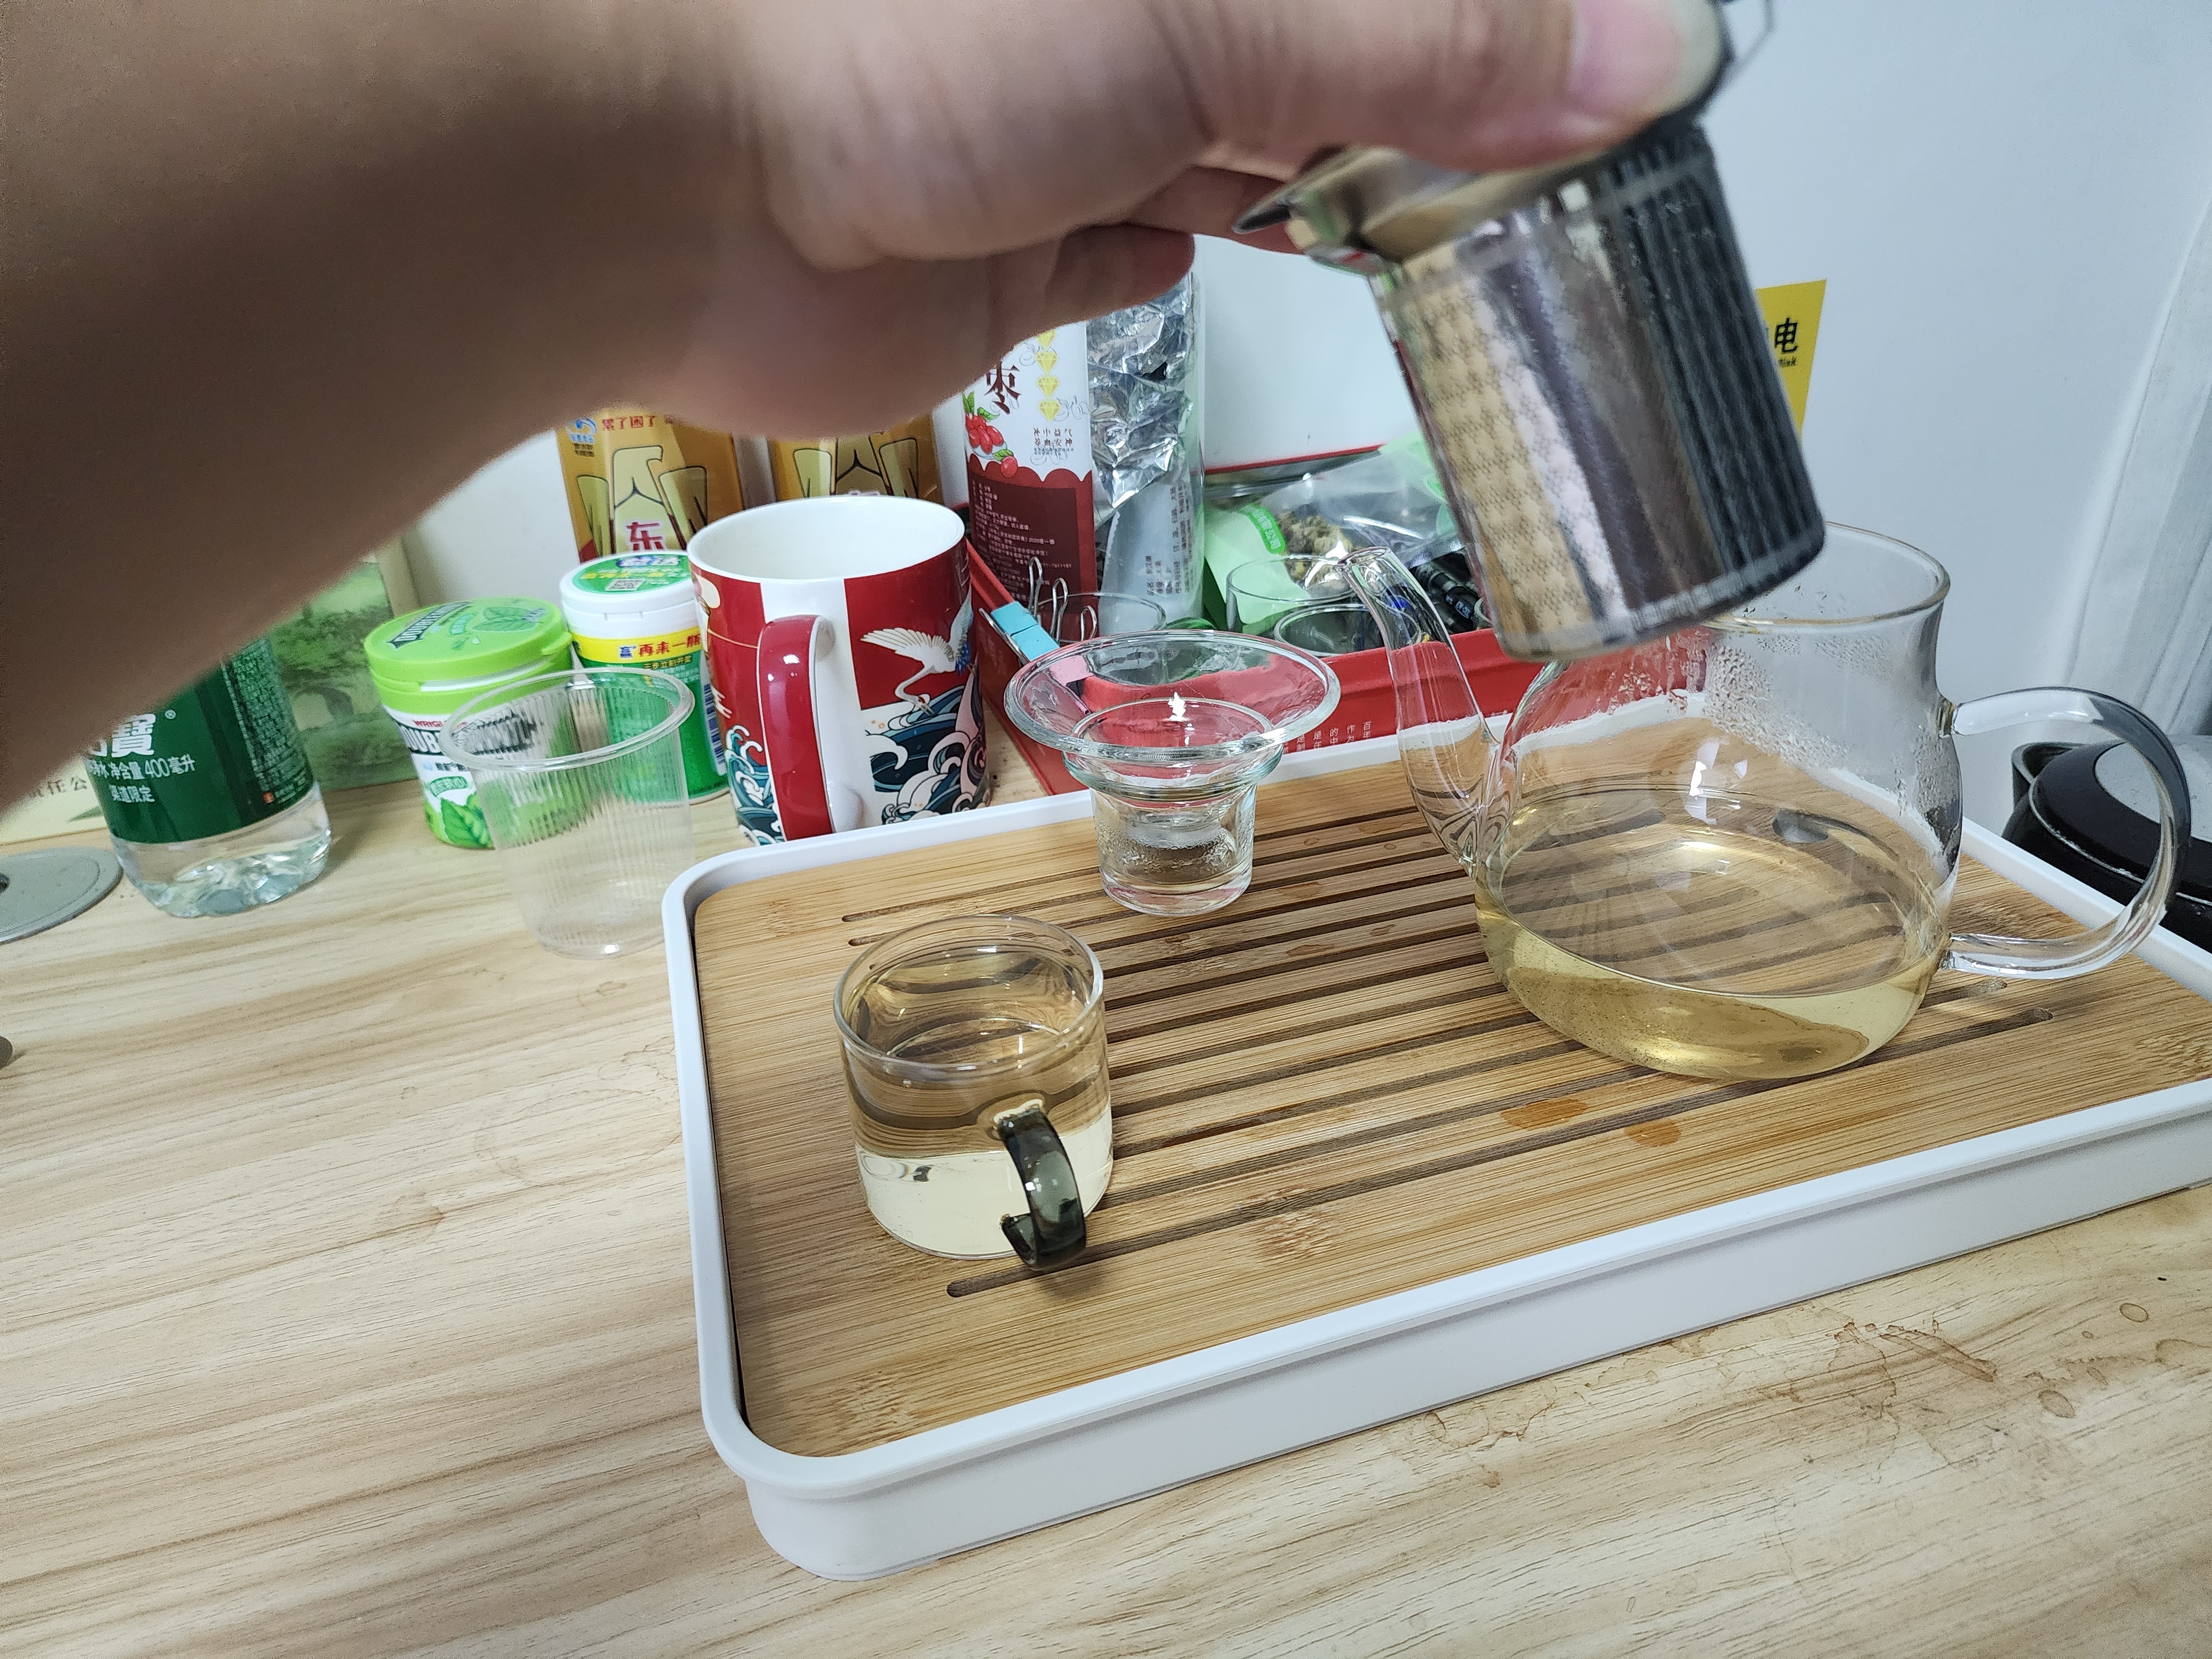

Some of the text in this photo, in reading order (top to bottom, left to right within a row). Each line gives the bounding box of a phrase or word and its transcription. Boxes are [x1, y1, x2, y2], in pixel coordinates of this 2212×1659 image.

[1774, 317, 1797, 353] 电
[983, 361, 1022, 415] 枣
[602, 415, 674, 431] 累了困了
[626, 521, 664, 551] 东
[638, 634, 701, 656] 再来一瓶
[88, 713, 156, 758] 寶
[413, 719, 443, 728] WRIG
[1363, 721, 1371, 738] 百年
